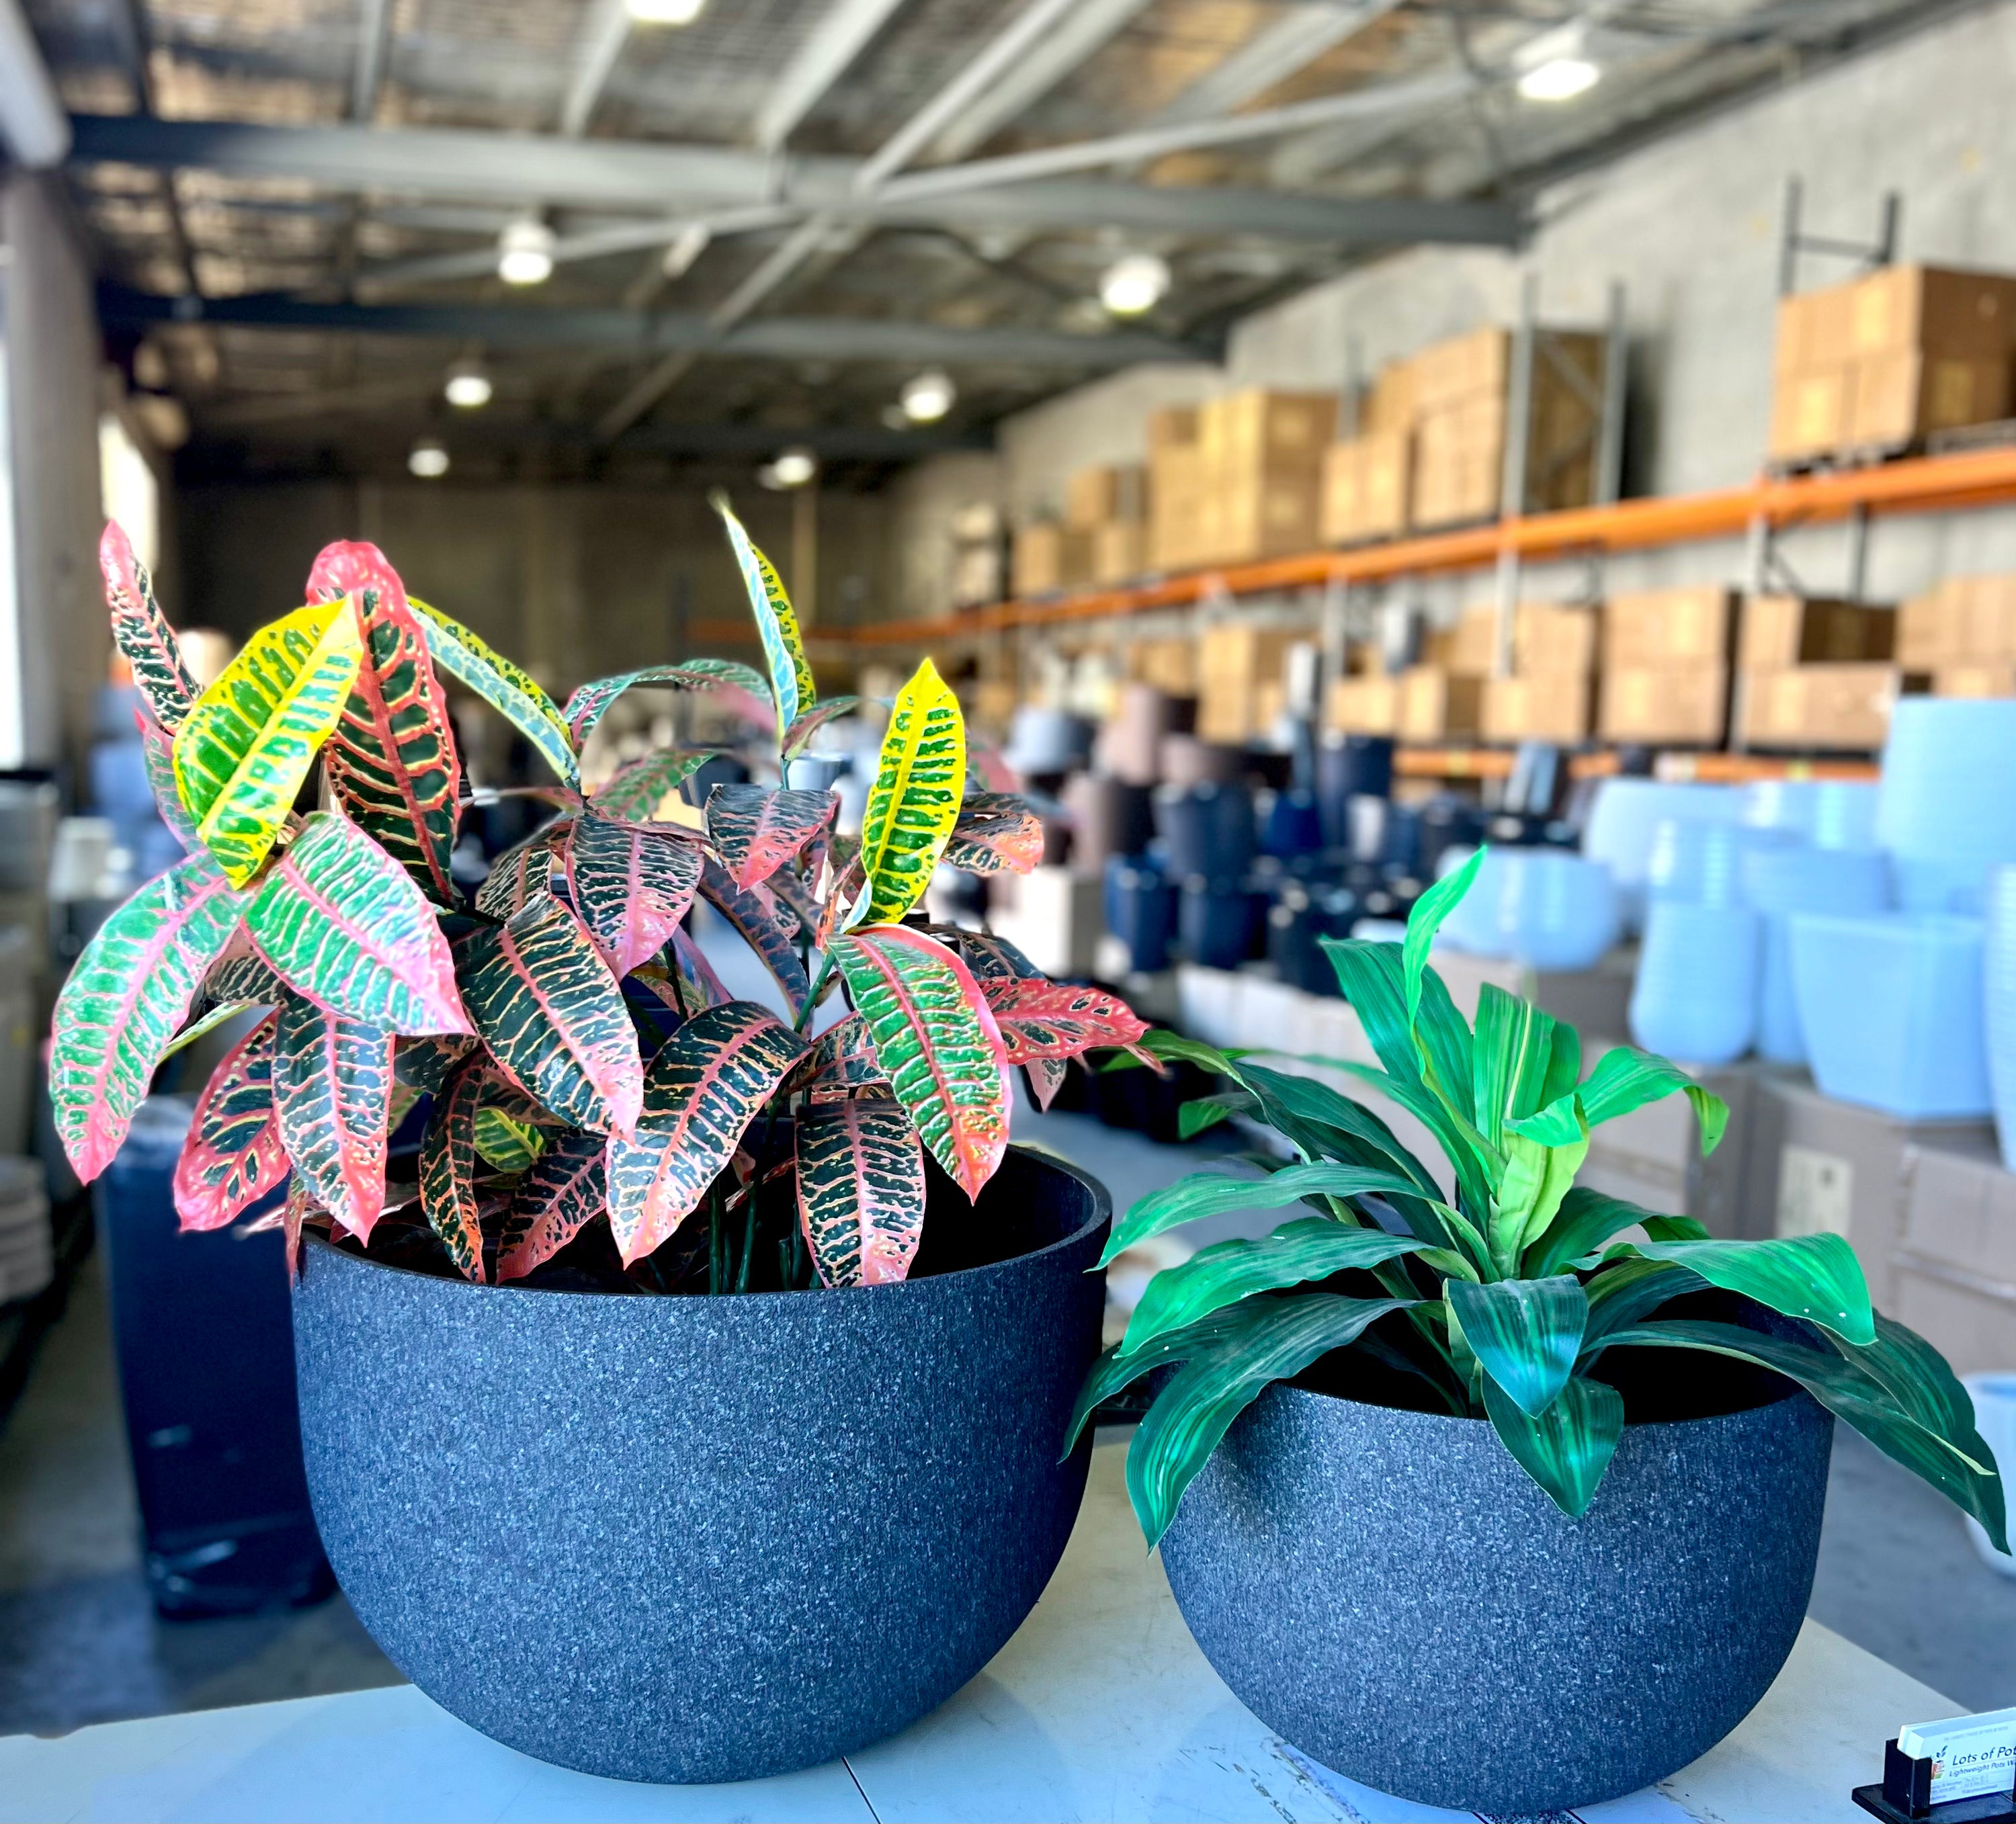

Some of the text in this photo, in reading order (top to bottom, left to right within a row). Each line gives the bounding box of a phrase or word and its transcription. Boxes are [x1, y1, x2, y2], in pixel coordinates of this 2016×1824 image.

[1952, 1753, 1977, 1766] Lots
[1980, 1747, 1995, 1760] of
[1949, 1765, 1990, 1777] Lightweight
